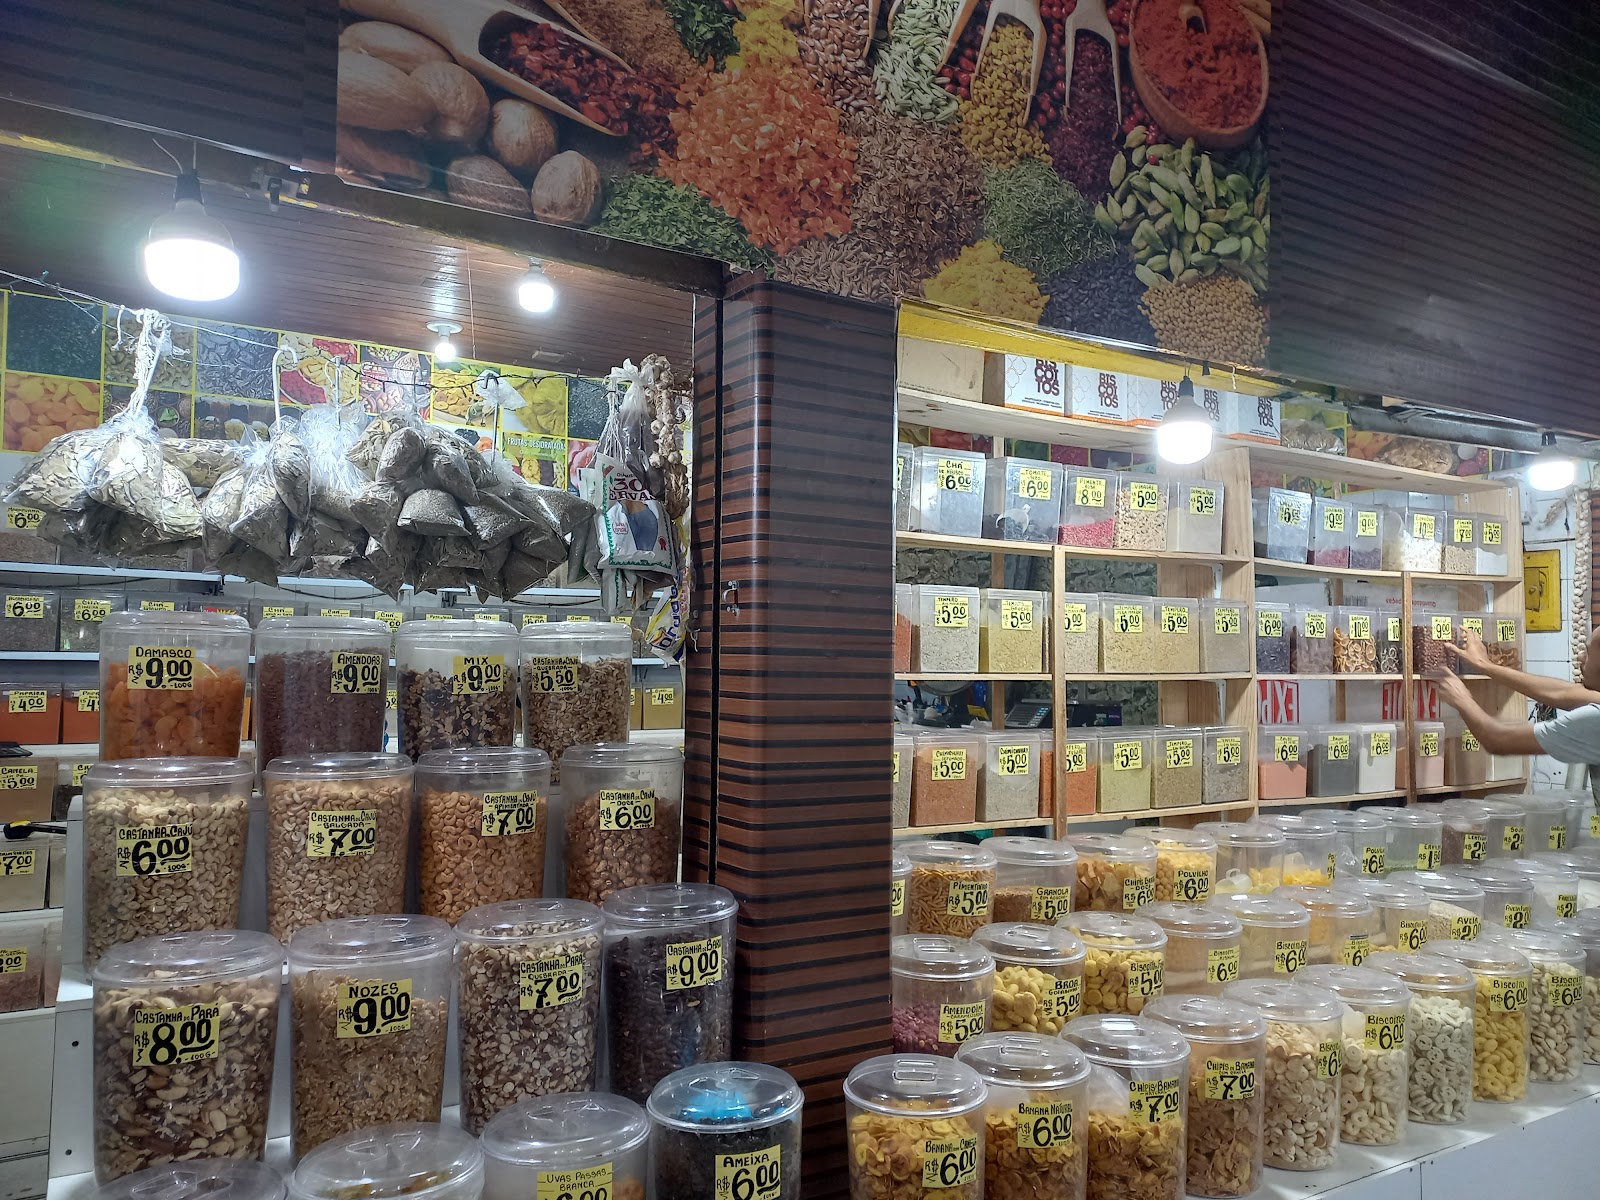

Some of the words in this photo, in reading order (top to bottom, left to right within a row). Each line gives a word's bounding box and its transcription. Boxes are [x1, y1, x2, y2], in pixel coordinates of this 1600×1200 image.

[1034, 367, 1059, 384] COI
[1100, 372, 1117, 387] BIS
[1036, 381, 1060, 396] TOS
[1098, 385, 1119, 399] COI
[1203, 389, 1218, 401] BIS
[1100, 394, 1119, 409] TOS
[1257, 402, 1274, 418] COI
[1258, 414, 1274, 428] TOS
[507, 437, 528, 447] FRUTAS
[945, 459, 963, 470] CHÁ
[613, 477, 644, 492] 30
[945, 474, 971, 490] 6.00
[1027, 480, 1049, 498] 6.00
[1080, 489, 1102, 505] 8.00
[1138, 491, 1157, 508] 5.00
[1196, 495, 1214, 513] 5.00
[14, 512, 40, 529] 6.00
[1328, 513, 1343, 529] 9.00
[13, 601, 41, 617] 6.00
[81, 609, 106, 621] 6.00
[941, 605, 967, 624] 5.00
[1011, 611, 1031, 628] 5.00
[1167, 615, 1188, 632] 5.00
[1264, 619, 1281, 635] 6.00
[1309, 621, 1325, 636] 5.00
[1436, 623, 1450, 639] 9.00
[136, 646, 192, 658] DAMASCO
[464, 656, 489, 666] MIX
[145, 658, 193, 689] 9.00
[343, 664, 380, 693] 9.00
[467, 664, 501, 691] 9.00
[540, 669, 575, 692] 5.50
[18, 697, 45, 712] 4.00
[1173, 748, 1191, 766] 5.00
[1223, 746, 1240, 763] 5.00
[1280, 744, 1298, 760] 6.00
[1333, 744, 1349, 759] 6.00
[1375, 743, 1389, 755] 6.00
[1424, 742, 1437, 756] 6.00
[1006, 755, 1028, 774] 5.00
[1120, 748, 1139, 768] 5.00
[940, 761, 964, 778] 5.00
[7, 777, 35, 789] 5.00
[485, 793, 518, 804] CASTANHA
[600, 791, 635, 801] CASTANHA
[311, 812, 355, 824] CASTANHA
[497, 806, 535, 836] 7.00
[615, 804, 653, 830] 6.00
[119, 826, 167, 840] CASTANHA
[308, 832, 325, 845] R$
[328, 828, 376, 857] 7.00
[131, 836, 191, 875] 6.00
[2, 855, 33, 876] 7.00
[1178, 870, 1209, 878] POLVILHO
[1036, 887, 1069, 896] GRANOLA
[1184, 877, 1209, 900] 6.00
[961, 889, 988, 916] 5.00
[1125, 893, 1136, 902] R$
[1044, 900, 1068, 920] 5.00
[668, 943, 702, 957] CASTANHA
[521, 960, 560, 973] CASTANHA
[679, 949, 719, 987] 9.00
[1216, 960, 1238, 981] 6.00
[527, 969, 567, 981] QUEBRADA
[350, 982, 398, 998] NOZES
[521, 984, 533, 997] R$
[534, 972, 581, 1009] 7.00
[1055, 979, 1079, 990] BROA
[1056, 993, 1081, 1017] 5.00
[1503, 987, 1528, 1011] 6.00
[135, 1008, 183, 1024] CASTANHA
[190, 1003, 220, 1019] PARÁ
[353, 992, 410, 1035] 9.00
[941, 1021, 953, 1034] R$
[954, 1016, 984, 1042] 5.00
[1379, 1023, 1405, 1050] 6.00
[134, 1031, 150, 1048] R$
[149, 1017, 214, 1065] 8.00
[1235, 1060, 1255, 1070] BANANA
[1219, 1072, 1255, 1099] 7.00
[1018, 1102, 1049, 1114] BANANA
[1050, 1102, 1073, 1114] NATURAL
[1130, 1100, 1143, 1111] R$
[1145, 1091, 1179, 1122] 7.00
[1018, 1121, 1031, 1135] R$
[1032, 1113, 1072, 1147] 6.00
[925, 1141, 953, 1153] BANANA
[924, 1157, 940, 1175] R$
[939, 1146, 977, 1186] 6.00
[547, 1173, 572, 1183] UVAS
[559, 1180, 596, 1192] BRANCA
[716, 1175, 730, 1192] R$
[731, 1160, 780, 1200] 6.00
